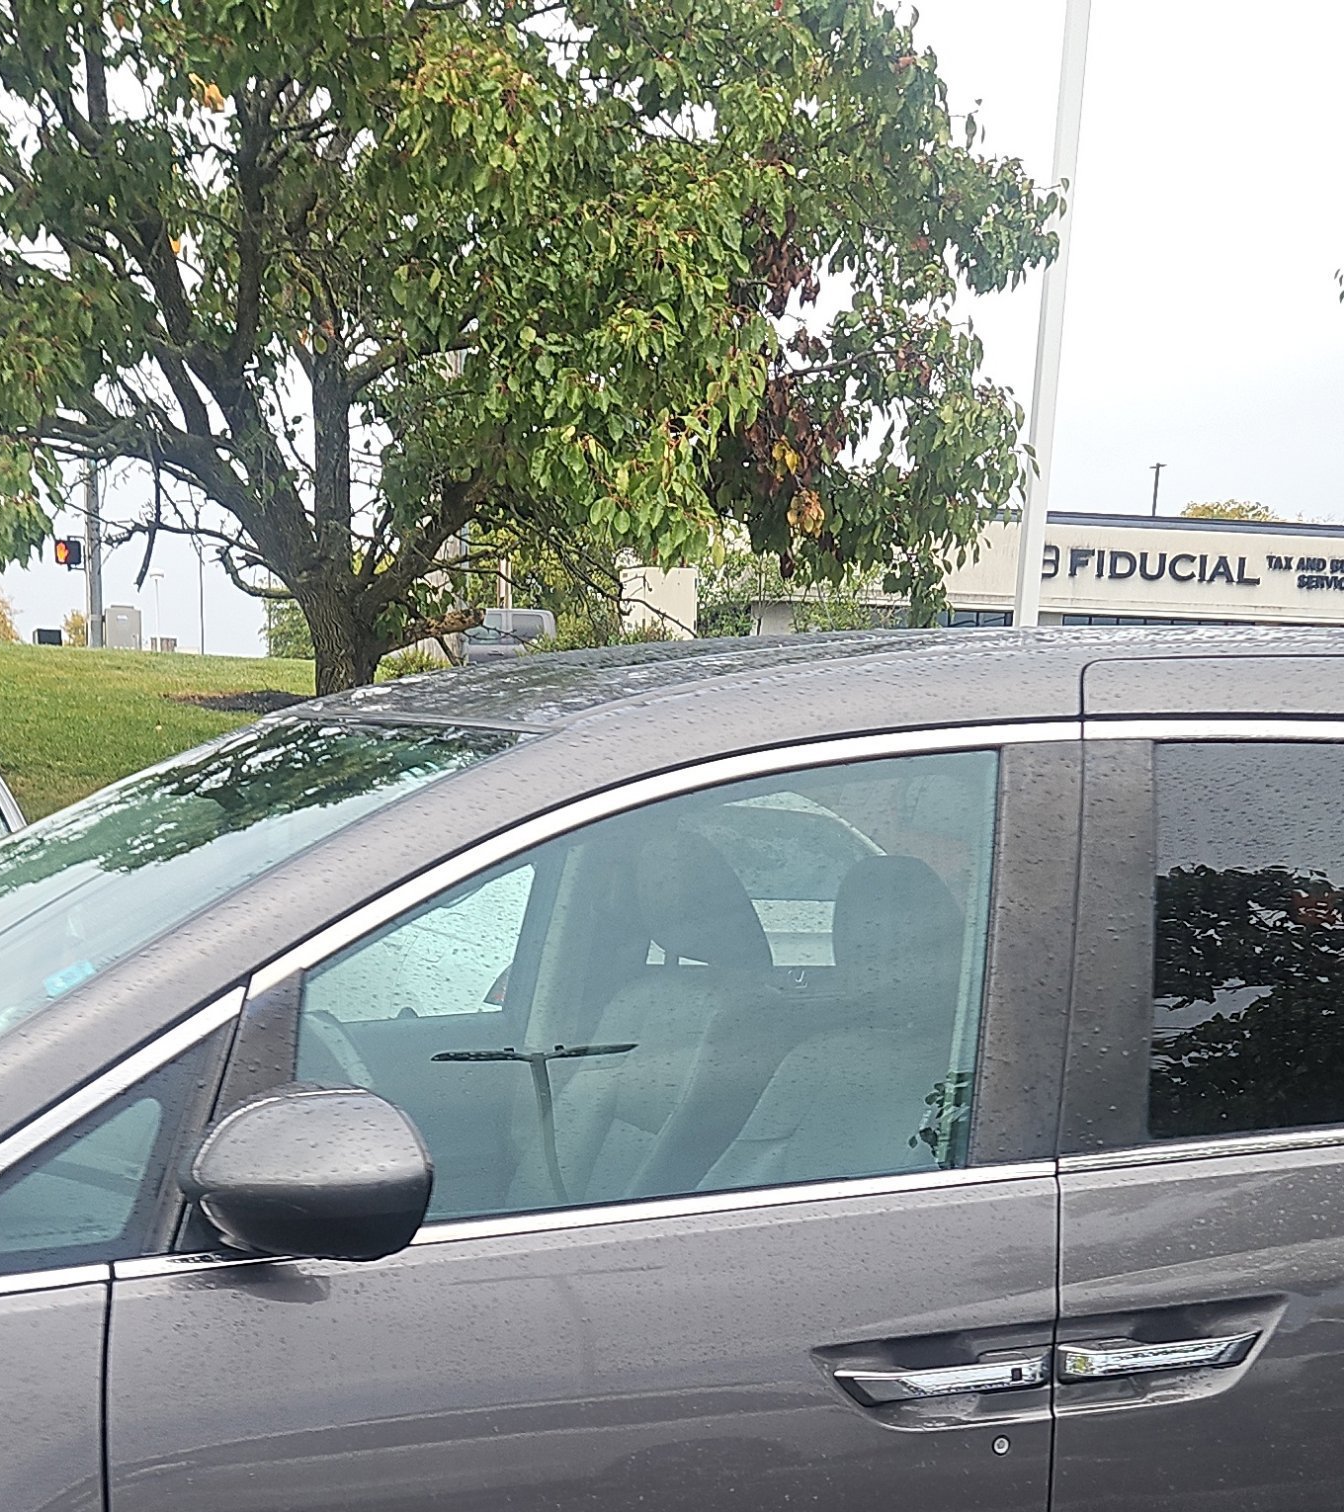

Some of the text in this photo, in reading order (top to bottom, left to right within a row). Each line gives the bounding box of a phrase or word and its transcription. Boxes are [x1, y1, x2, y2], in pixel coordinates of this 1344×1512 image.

[1068, 548, 1260, 585] FIDUCIAL
[1266, 555, 1293, 570] TAX
[1296, 557, 1326, 572] AND
